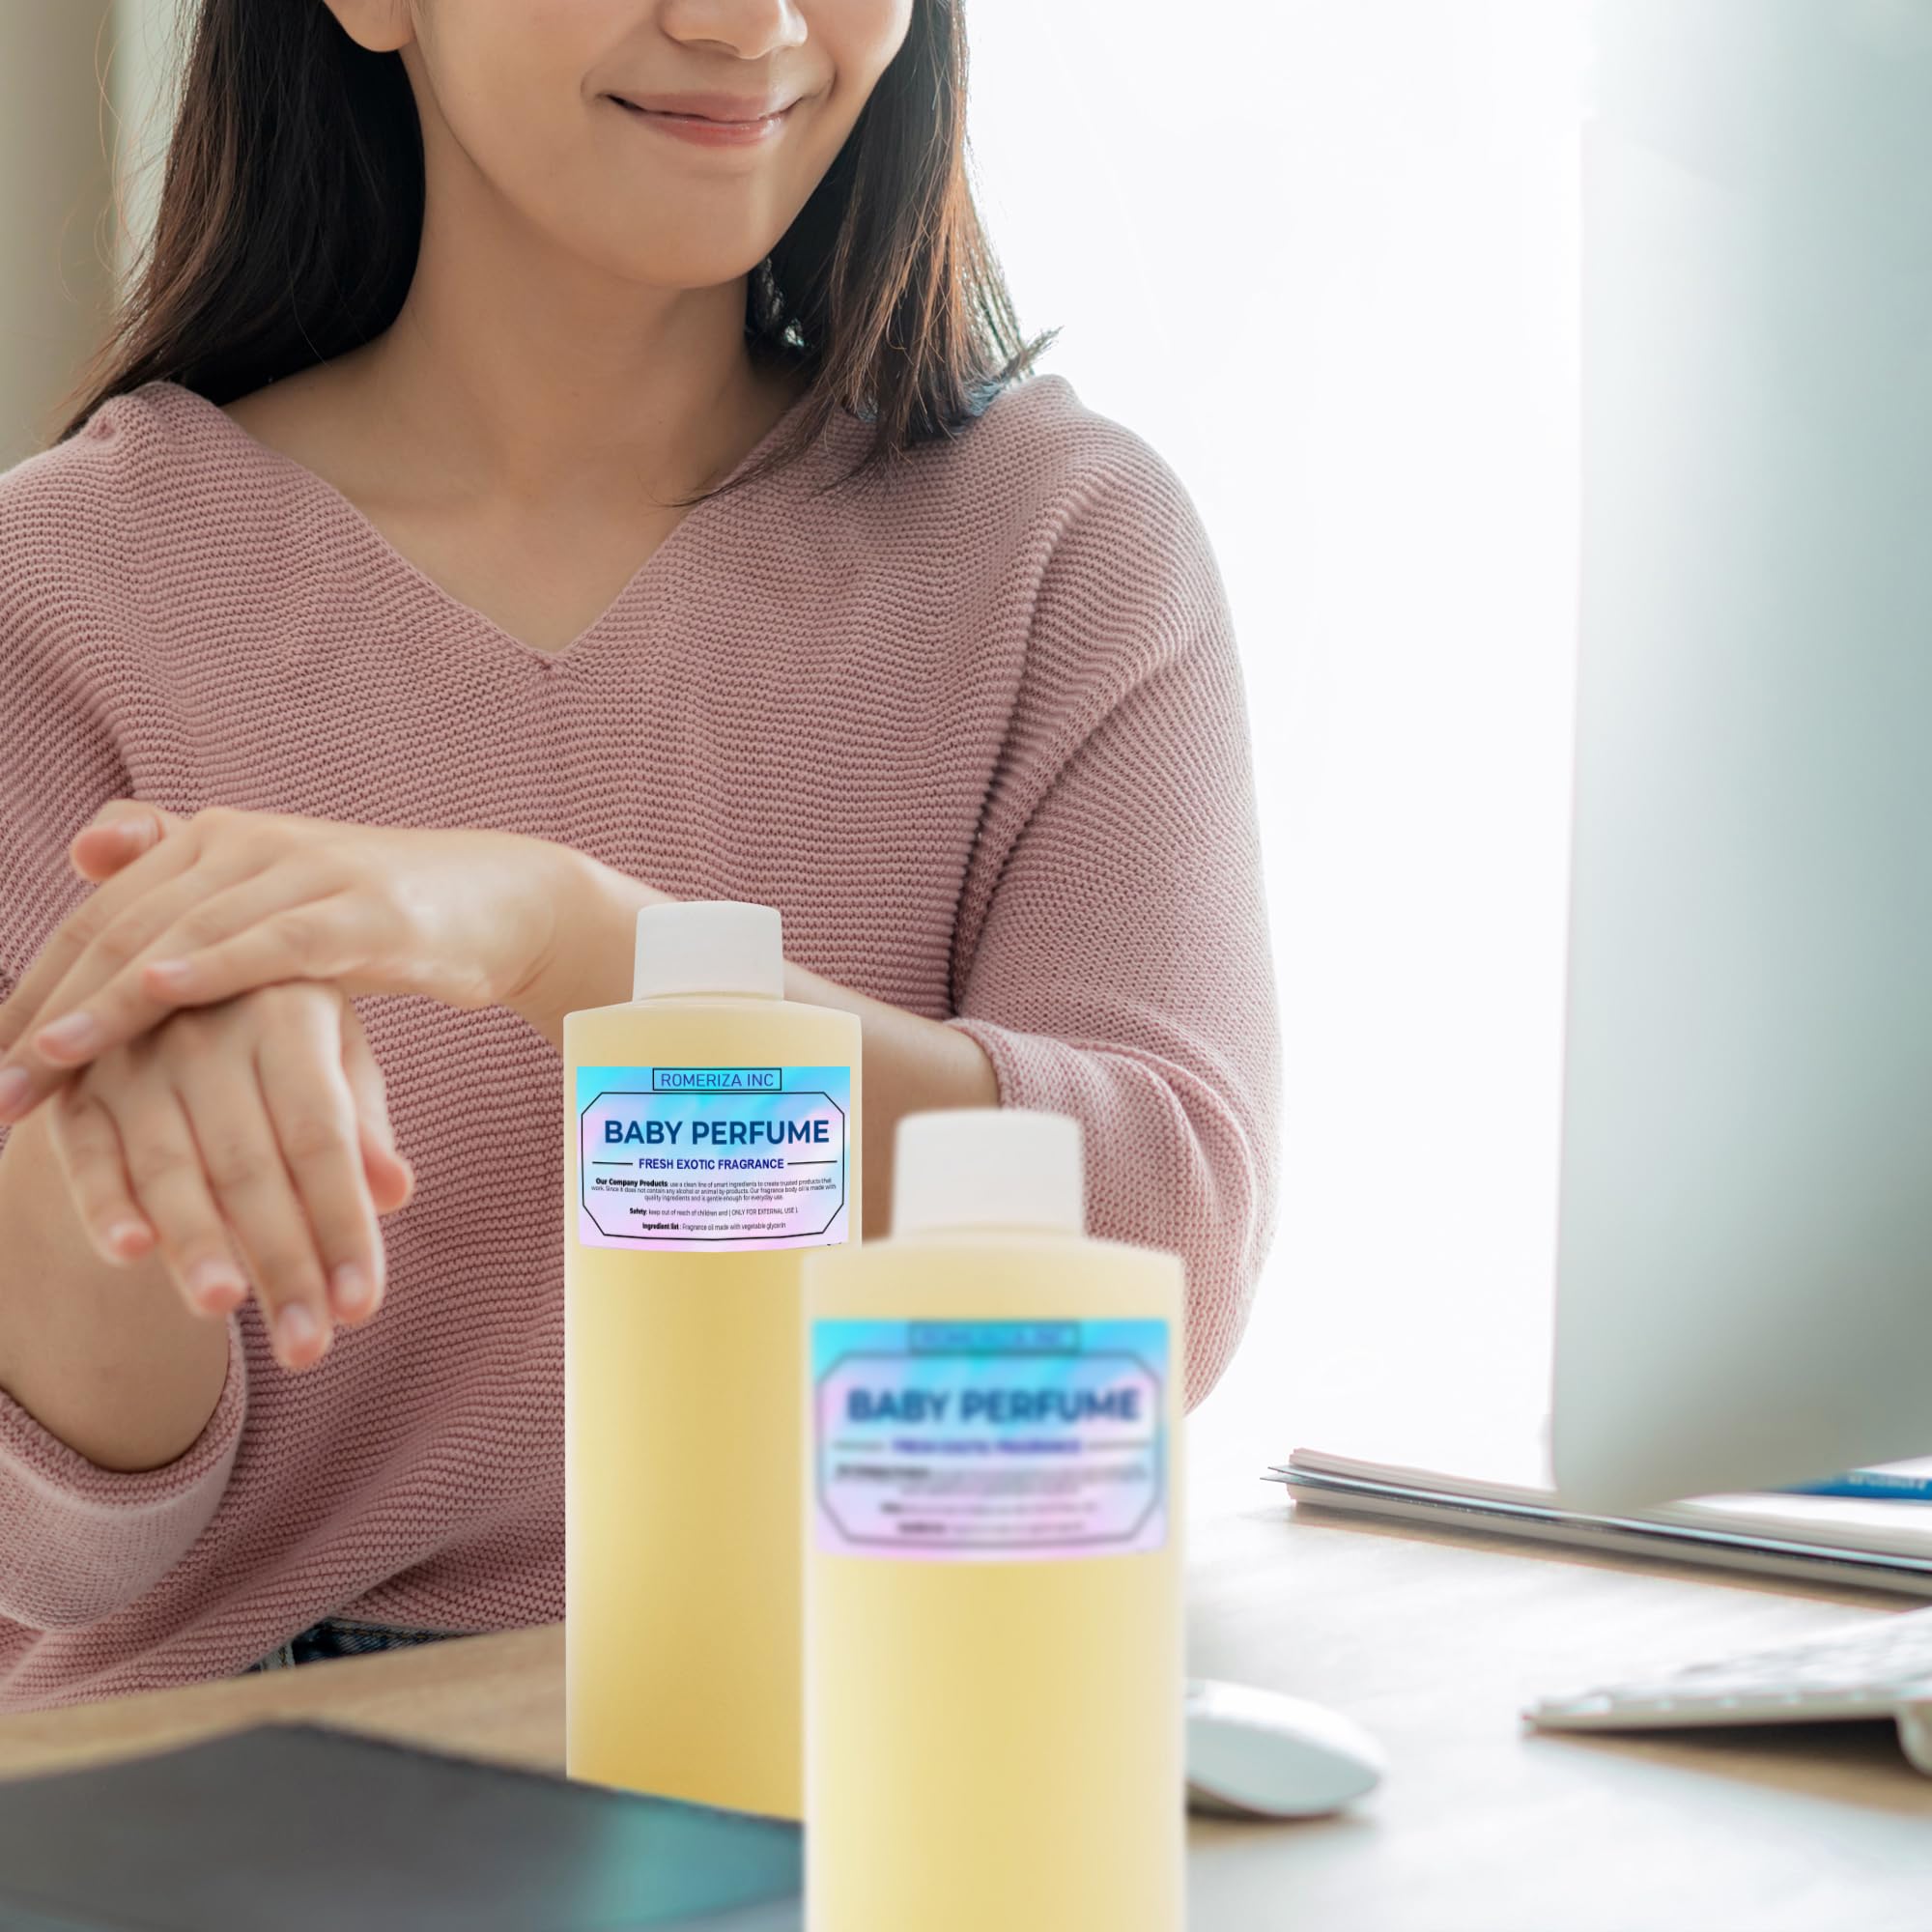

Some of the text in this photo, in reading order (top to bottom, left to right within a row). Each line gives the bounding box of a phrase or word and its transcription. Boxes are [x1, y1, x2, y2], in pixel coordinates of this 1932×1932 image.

[661, 1073, 774, 1087] ROMERIZA INC
[605, 1120, 830, 1146] BABY PERFUME
[639, 1158, 784, 1170] FRESH EXOTIC FRAGRANCE
[846, 1386, 1140, 1423] BABY PERFUME
